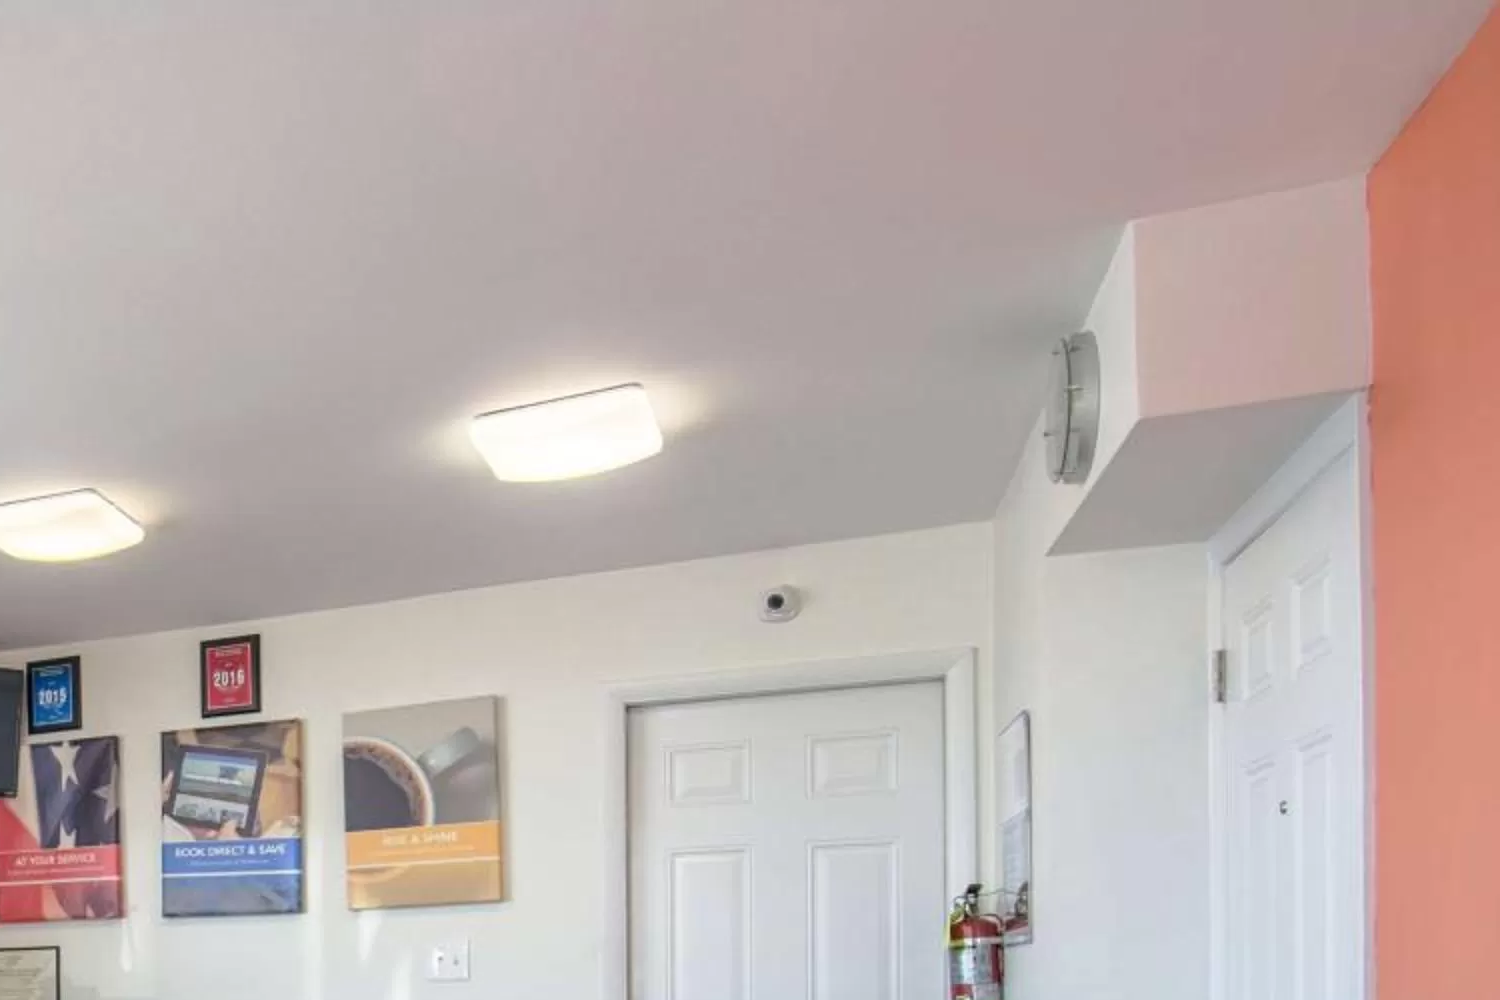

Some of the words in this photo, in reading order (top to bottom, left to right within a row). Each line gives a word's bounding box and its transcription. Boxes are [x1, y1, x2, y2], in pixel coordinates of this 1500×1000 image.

[213, 669, 245, 687] 2016
[38, 687, 68, 706] 2015
[175, 847, 206, 858] BOOK
[208, 845, 246, 858] DIRECT
[259, 843, 287, 855] SAVE
